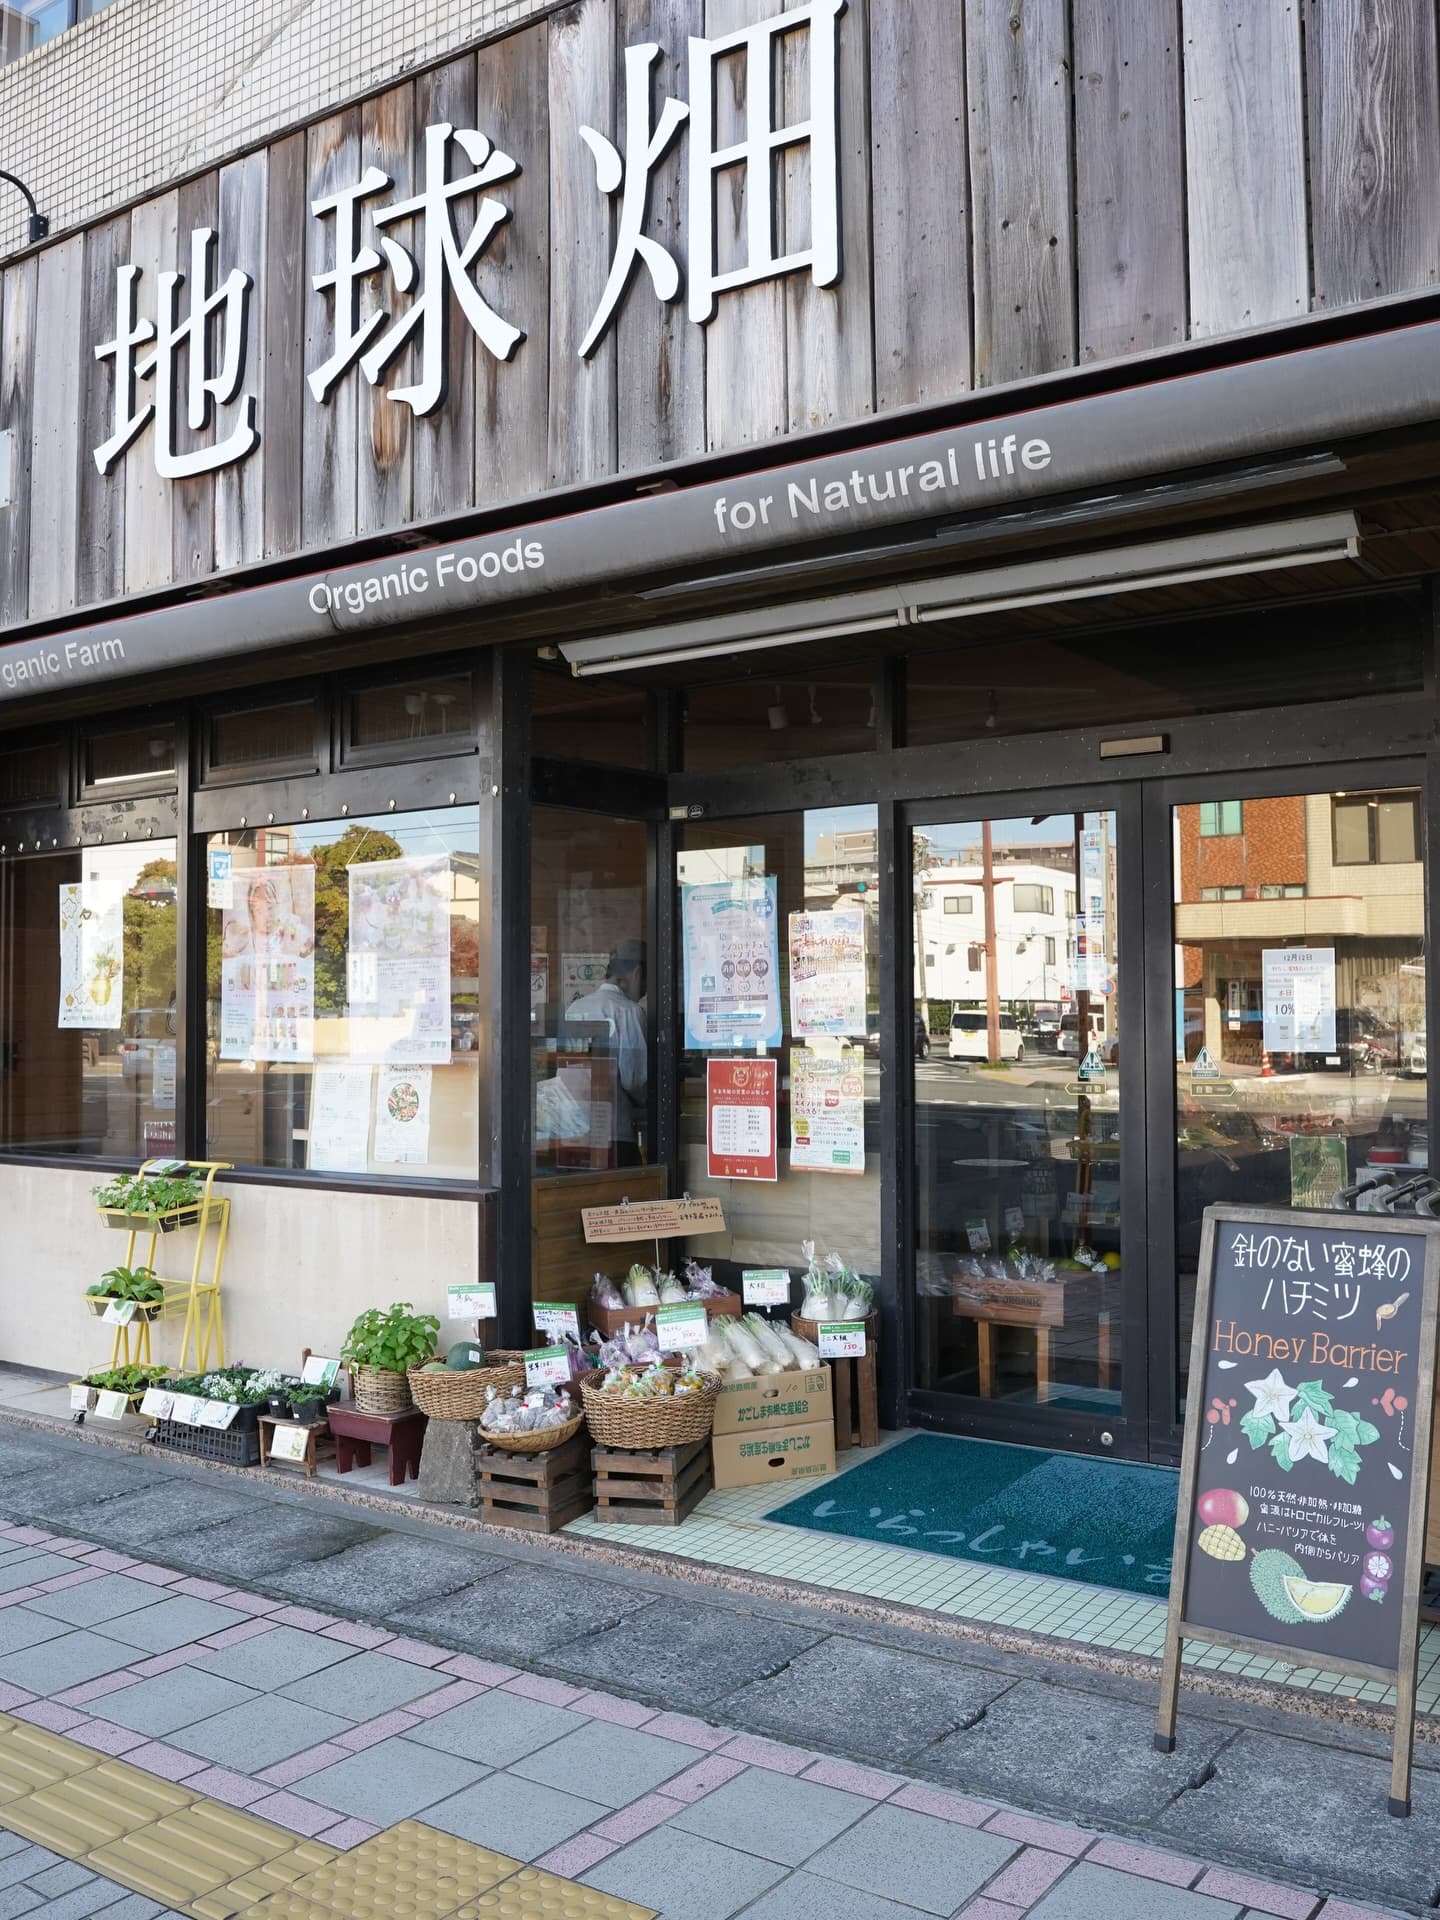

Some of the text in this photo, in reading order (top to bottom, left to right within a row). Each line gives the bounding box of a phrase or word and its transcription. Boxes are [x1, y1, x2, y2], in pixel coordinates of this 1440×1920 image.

[93, 0, 846, 480] 地球畑
[713, 434, 1052, 533] for Natural life
[308, 539, 545, 614] Organic Foods
[64, 637, 126, 669] Farm
[1283, 953, 1313, 962] 12月12日
[1231, 1233, 1411, 1281] 針のない蜜蜂の
[1261, 1278, 1361, 1320] ハチミツ
[1212, 1319, 1408, 1374] Honey Barrier
[1294, 1542, 1360, 1565] 内側からバリア
